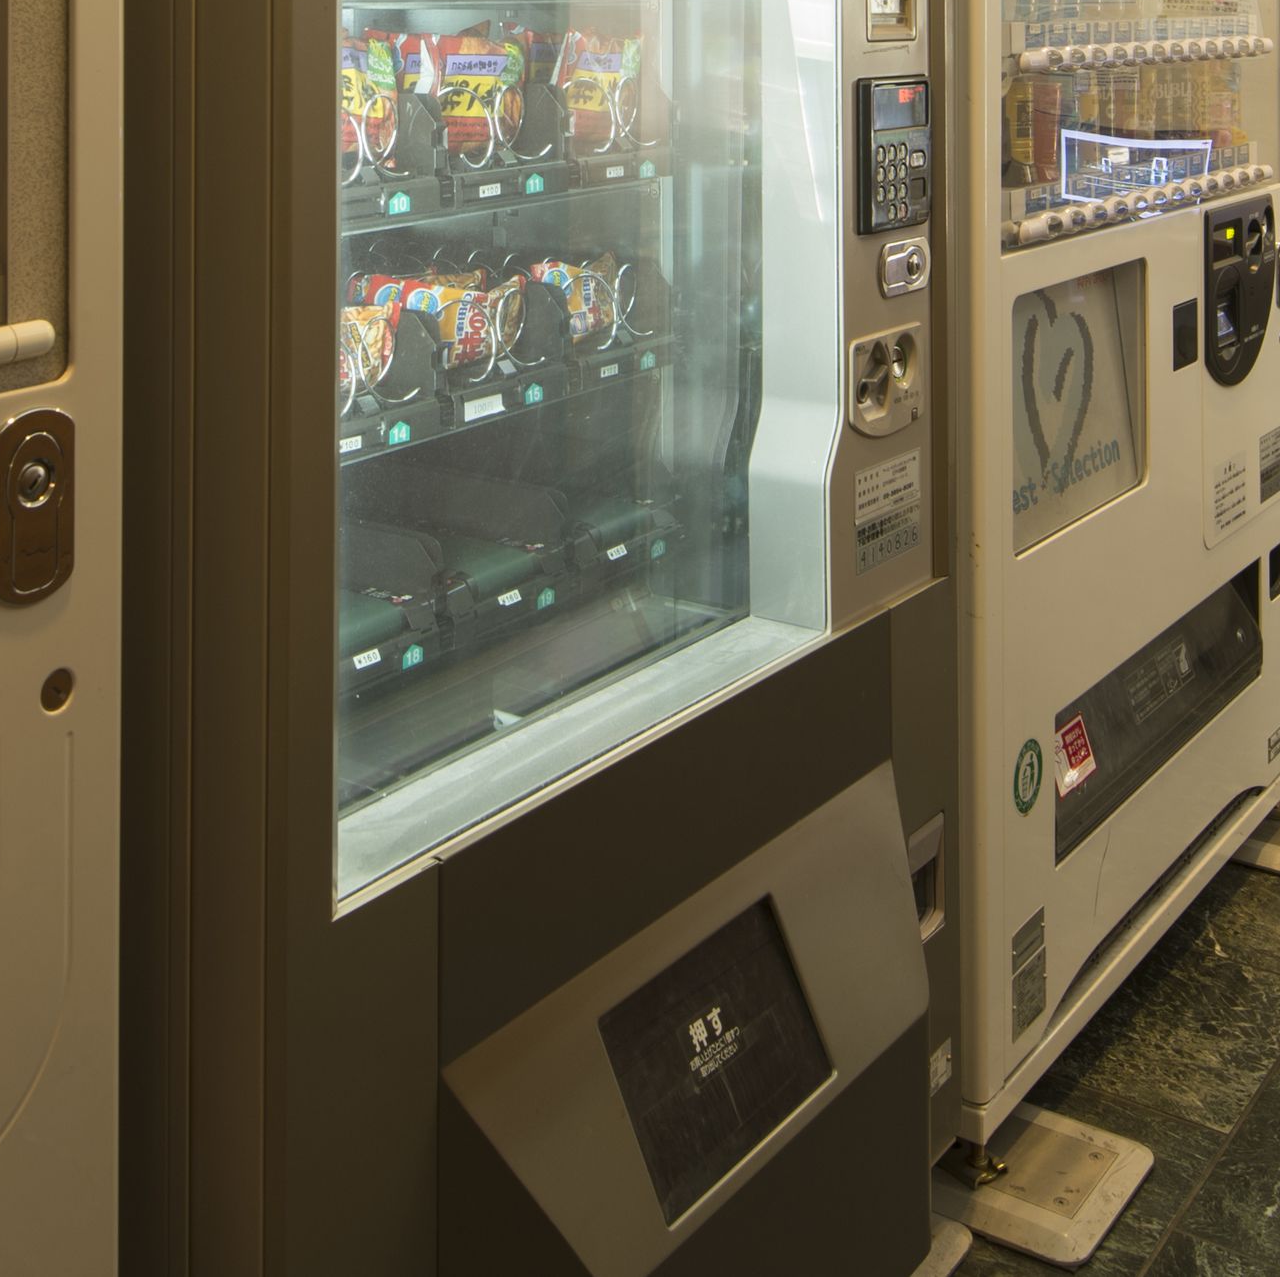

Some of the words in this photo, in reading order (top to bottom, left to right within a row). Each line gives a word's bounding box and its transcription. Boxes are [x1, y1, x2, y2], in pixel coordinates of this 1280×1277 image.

[529, 177, 540, 191] 11
[392, 197, 407, 212] 10
[529, 388, 540, 402] 15
[393, 428, 407, 442] 14
[541, 592, 553, 608] 19
[406, 648, 421, 666] 18
[688, 1007, 723, 1053] 押す
